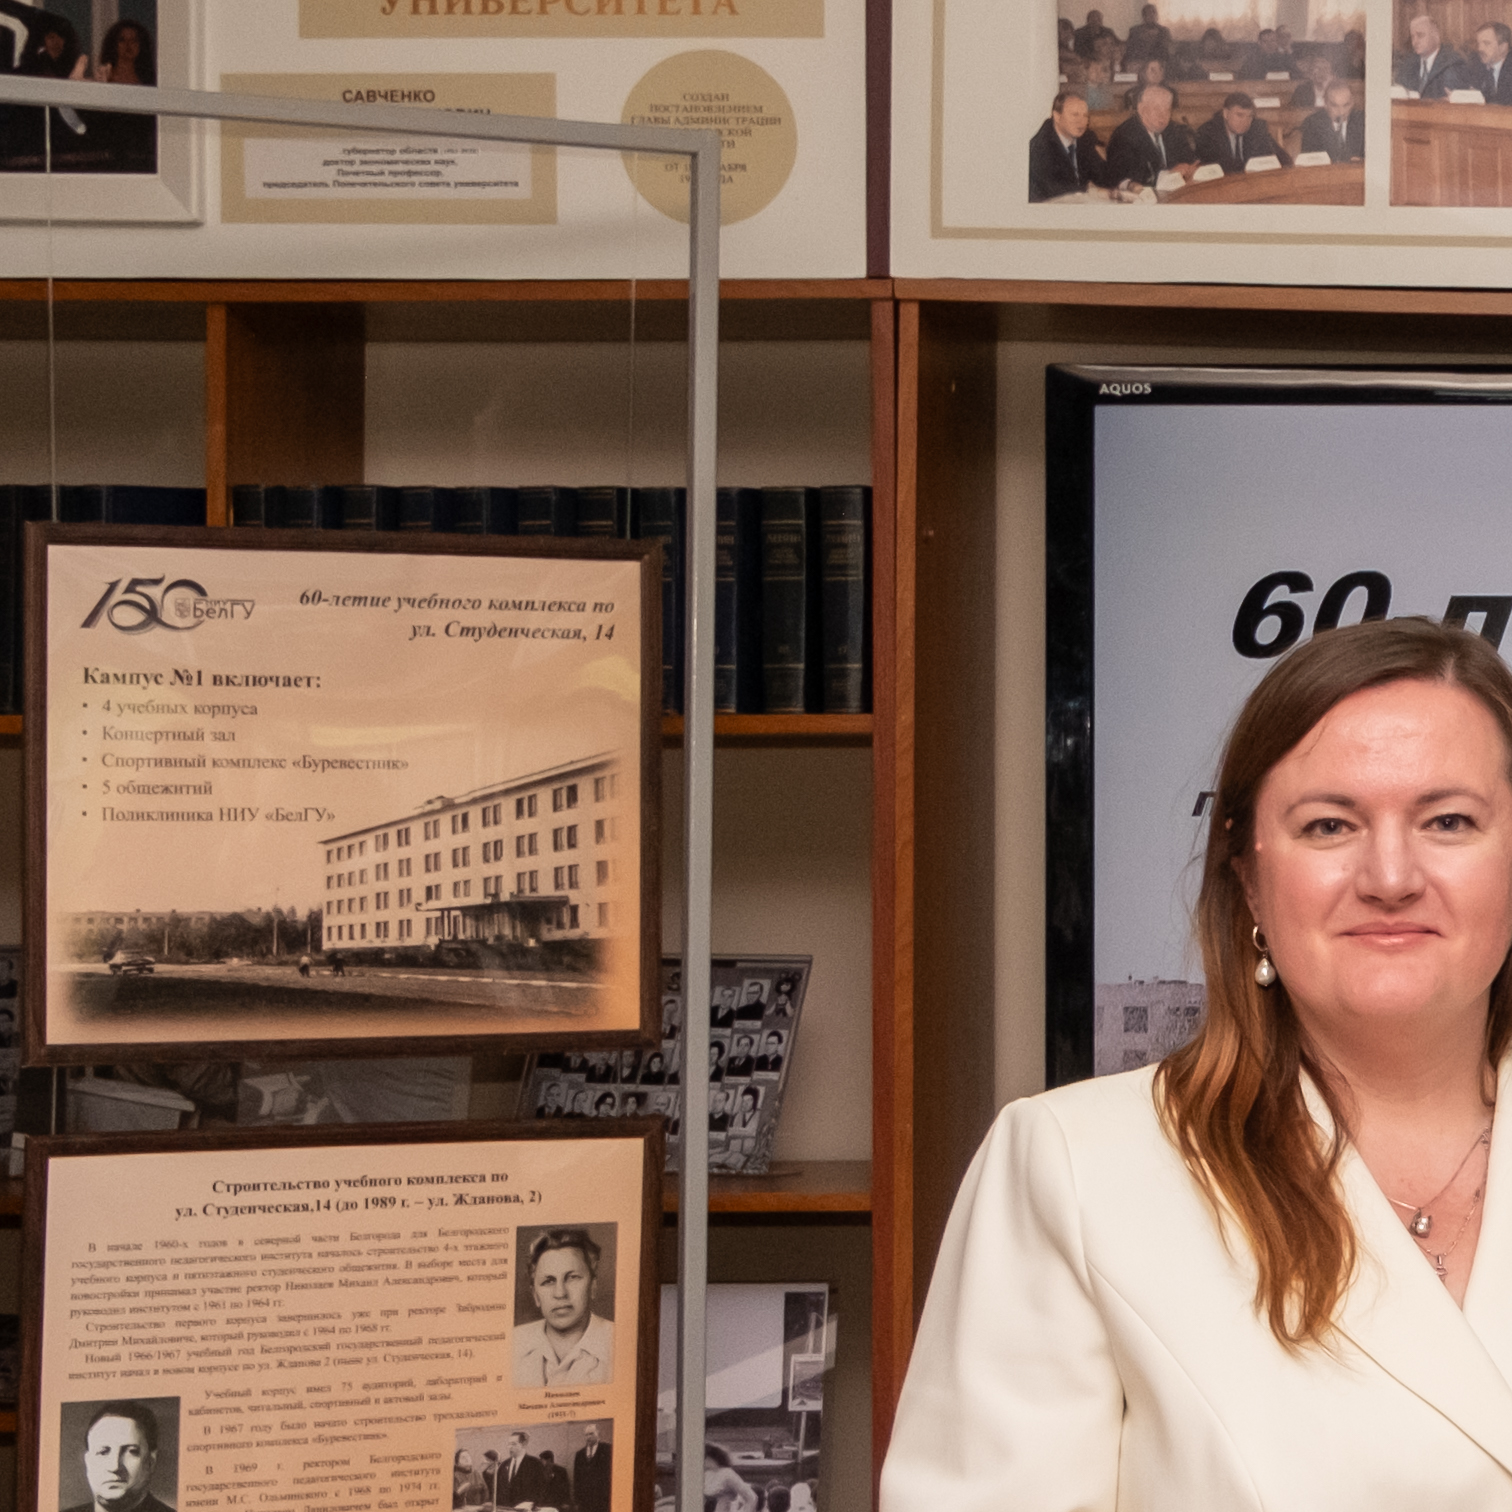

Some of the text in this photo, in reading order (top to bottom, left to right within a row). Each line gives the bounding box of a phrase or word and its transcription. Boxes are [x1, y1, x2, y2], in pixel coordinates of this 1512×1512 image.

[341, 89, 436, 104] САВЧЕНКО
[1099, 383, 1152, 396] AQUOS
[192, 601, 256, 620] БелГУ
[299, 588, 616, 614] 60-летие учебного комплекса по
[408, 620, 616, 642] ул. Студенческая, 14
[83, 667, 322, 690] Кампус №1 включает:
[101, 700, 258, 719] 4 учебных корпуса
[102, 725, 236, 743] Концертный зал
[101, 753, 410, 773] Спортивный комплекс «Буревестник»
[102, 783, 111, 795] 5
[102, 807, 336, 824] Поликлиника НИУ «БелГУ»
[211, 1170, 509, 1196] Строительство учебного комплекса по
[175, 1205, 199, 1220] ул.
[336, 1198, 359, 1214] (до
[363, 1196, 397, 1211] 1989
[427, 1194, 449, 1209] ул.
[453, 1191, 525, 1208] Жданова,
[528, 1190, 543, 1206] 2)
